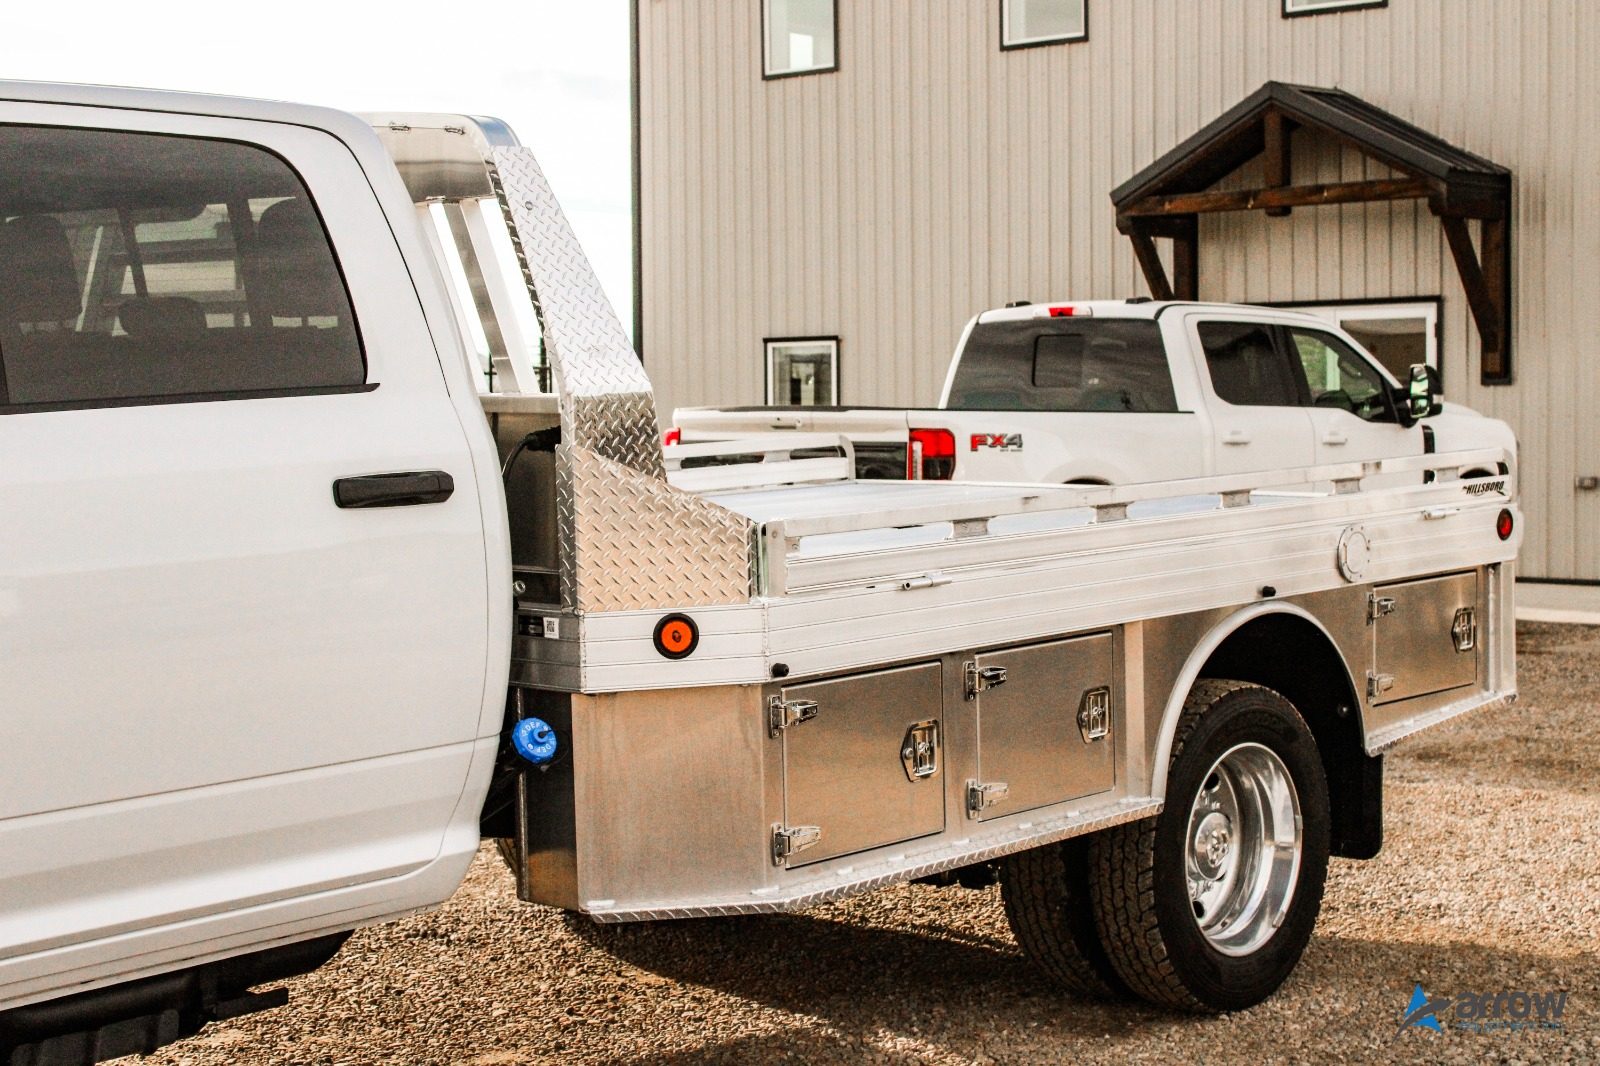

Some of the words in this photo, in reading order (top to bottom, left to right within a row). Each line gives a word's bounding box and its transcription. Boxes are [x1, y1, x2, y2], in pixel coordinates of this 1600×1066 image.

[970, 433, 1023, 451] FX4
[1465, 481, 1505, 494] HILLSBORO
[525, 721, 540, 731] DEF
